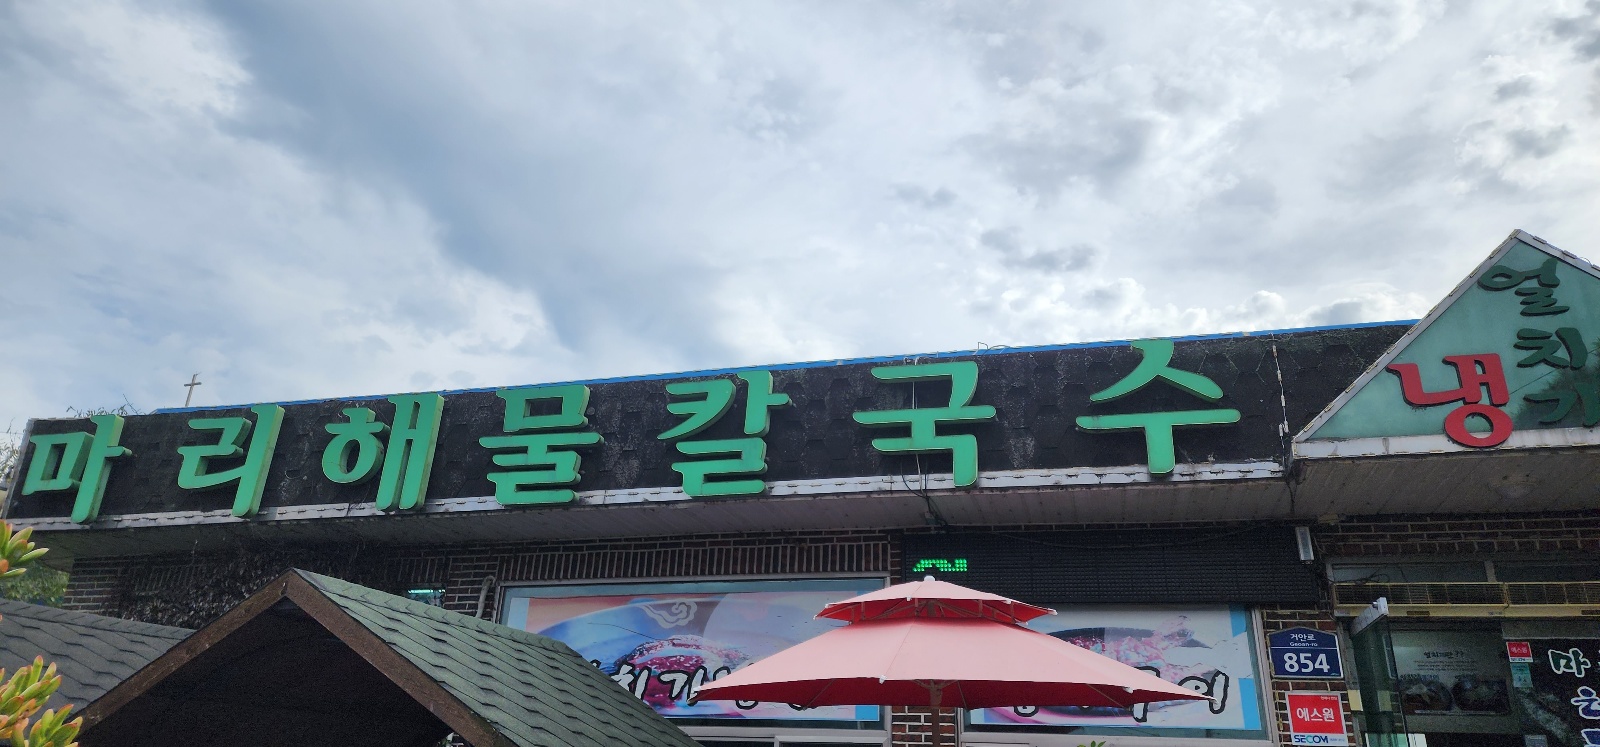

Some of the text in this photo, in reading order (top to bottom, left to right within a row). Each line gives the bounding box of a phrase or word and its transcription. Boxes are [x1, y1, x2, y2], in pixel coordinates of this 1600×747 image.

[1386, 353, 1514, 447] 냉
[1289, 633, 1316, 642] 거안로
[1283, 652, 1331, 673] 854
[1296, 707, 1335, 722] 에스원
[1293, 735, 1329, 744] SECOM
